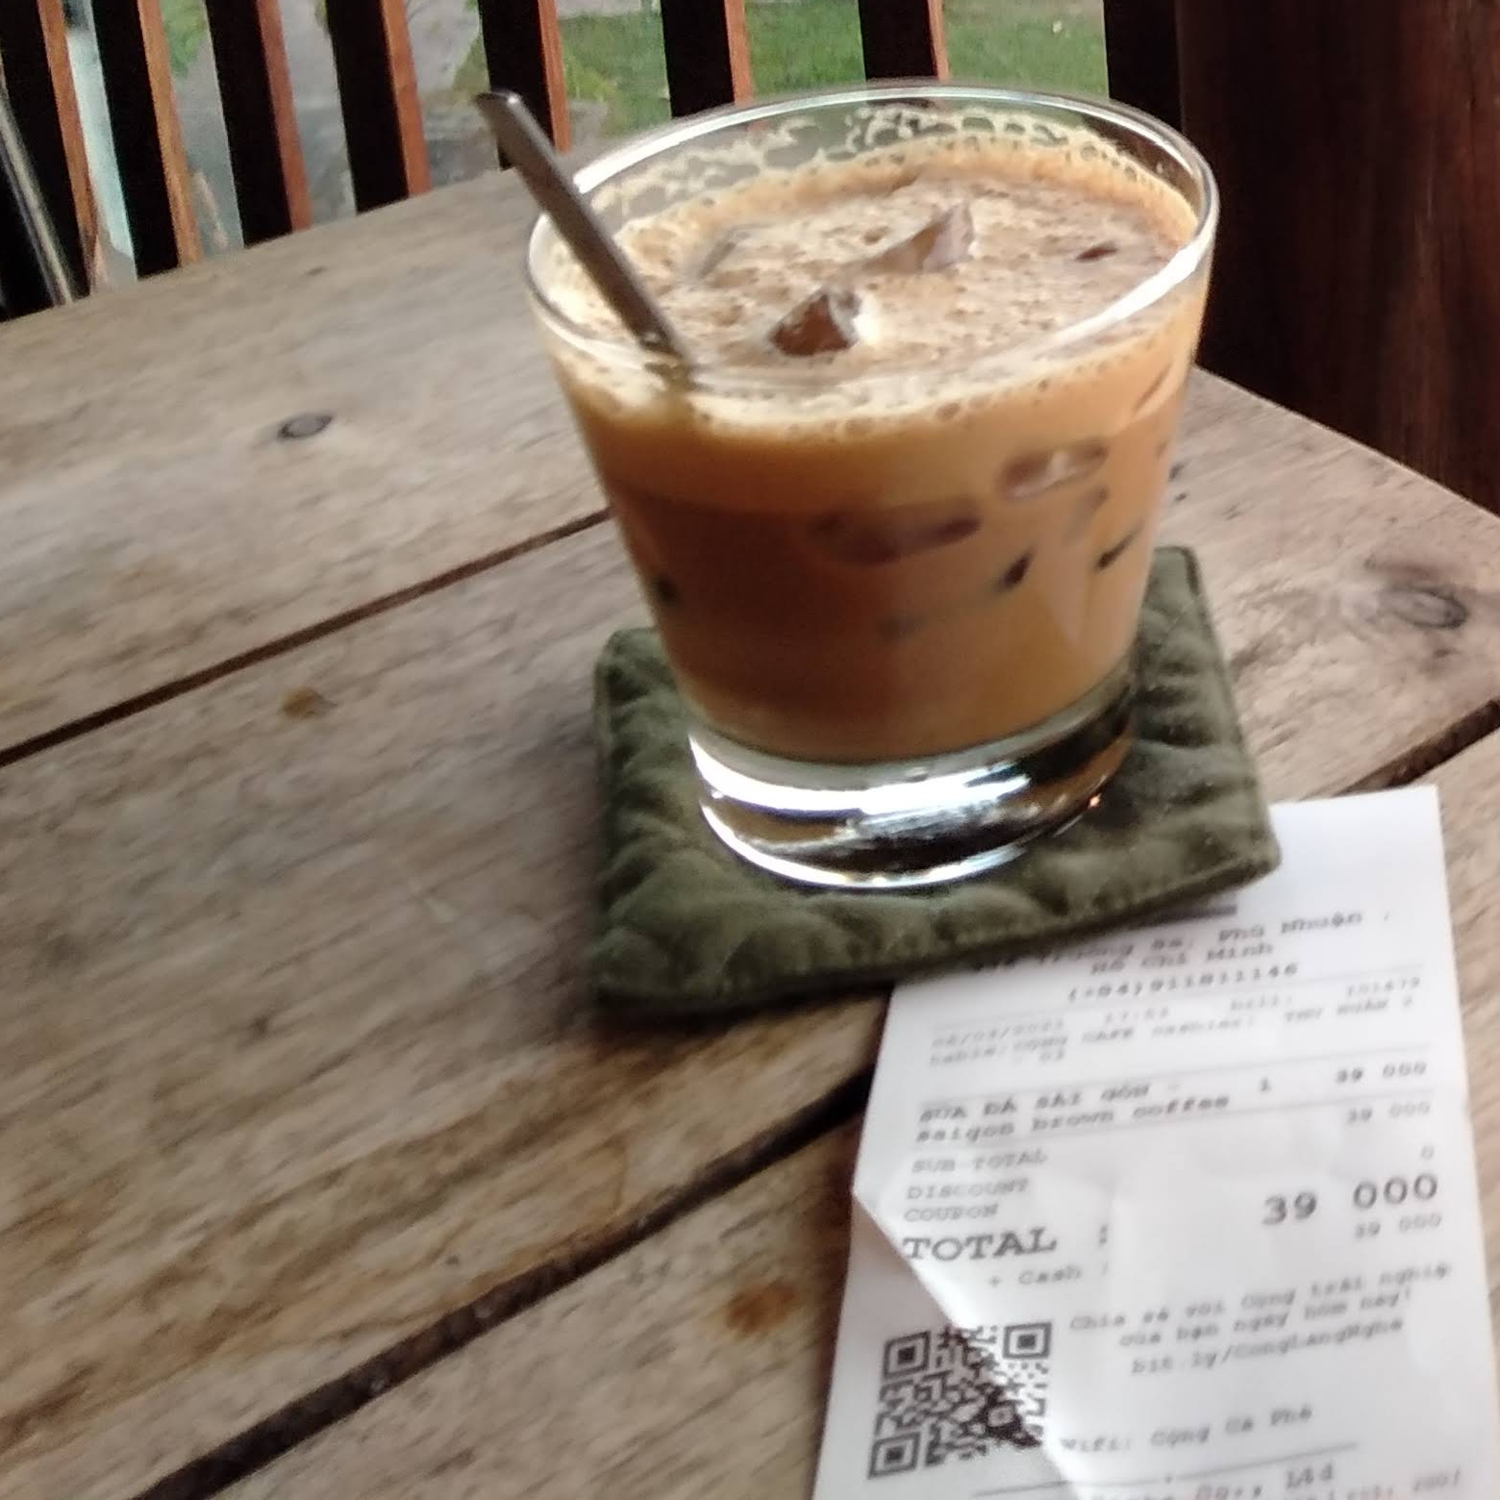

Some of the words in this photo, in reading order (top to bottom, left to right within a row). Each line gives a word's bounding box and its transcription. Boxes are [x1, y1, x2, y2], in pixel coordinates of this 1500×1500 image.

[1382, 1060, 1428, 1078] 000
[1389, 1099, 1432, 1118] 000
[905, 1176, 1030, 1201] DISCOUNT
[902, 1225, 1057, 1261] TOTAL
[1261, 1190, 1318, 1226] 39
[1352, 1172, 1438, 1210] 000
[1018, 1263, 1082, 1286] Cash
[1399, 1211, 1442, 1233] 000
